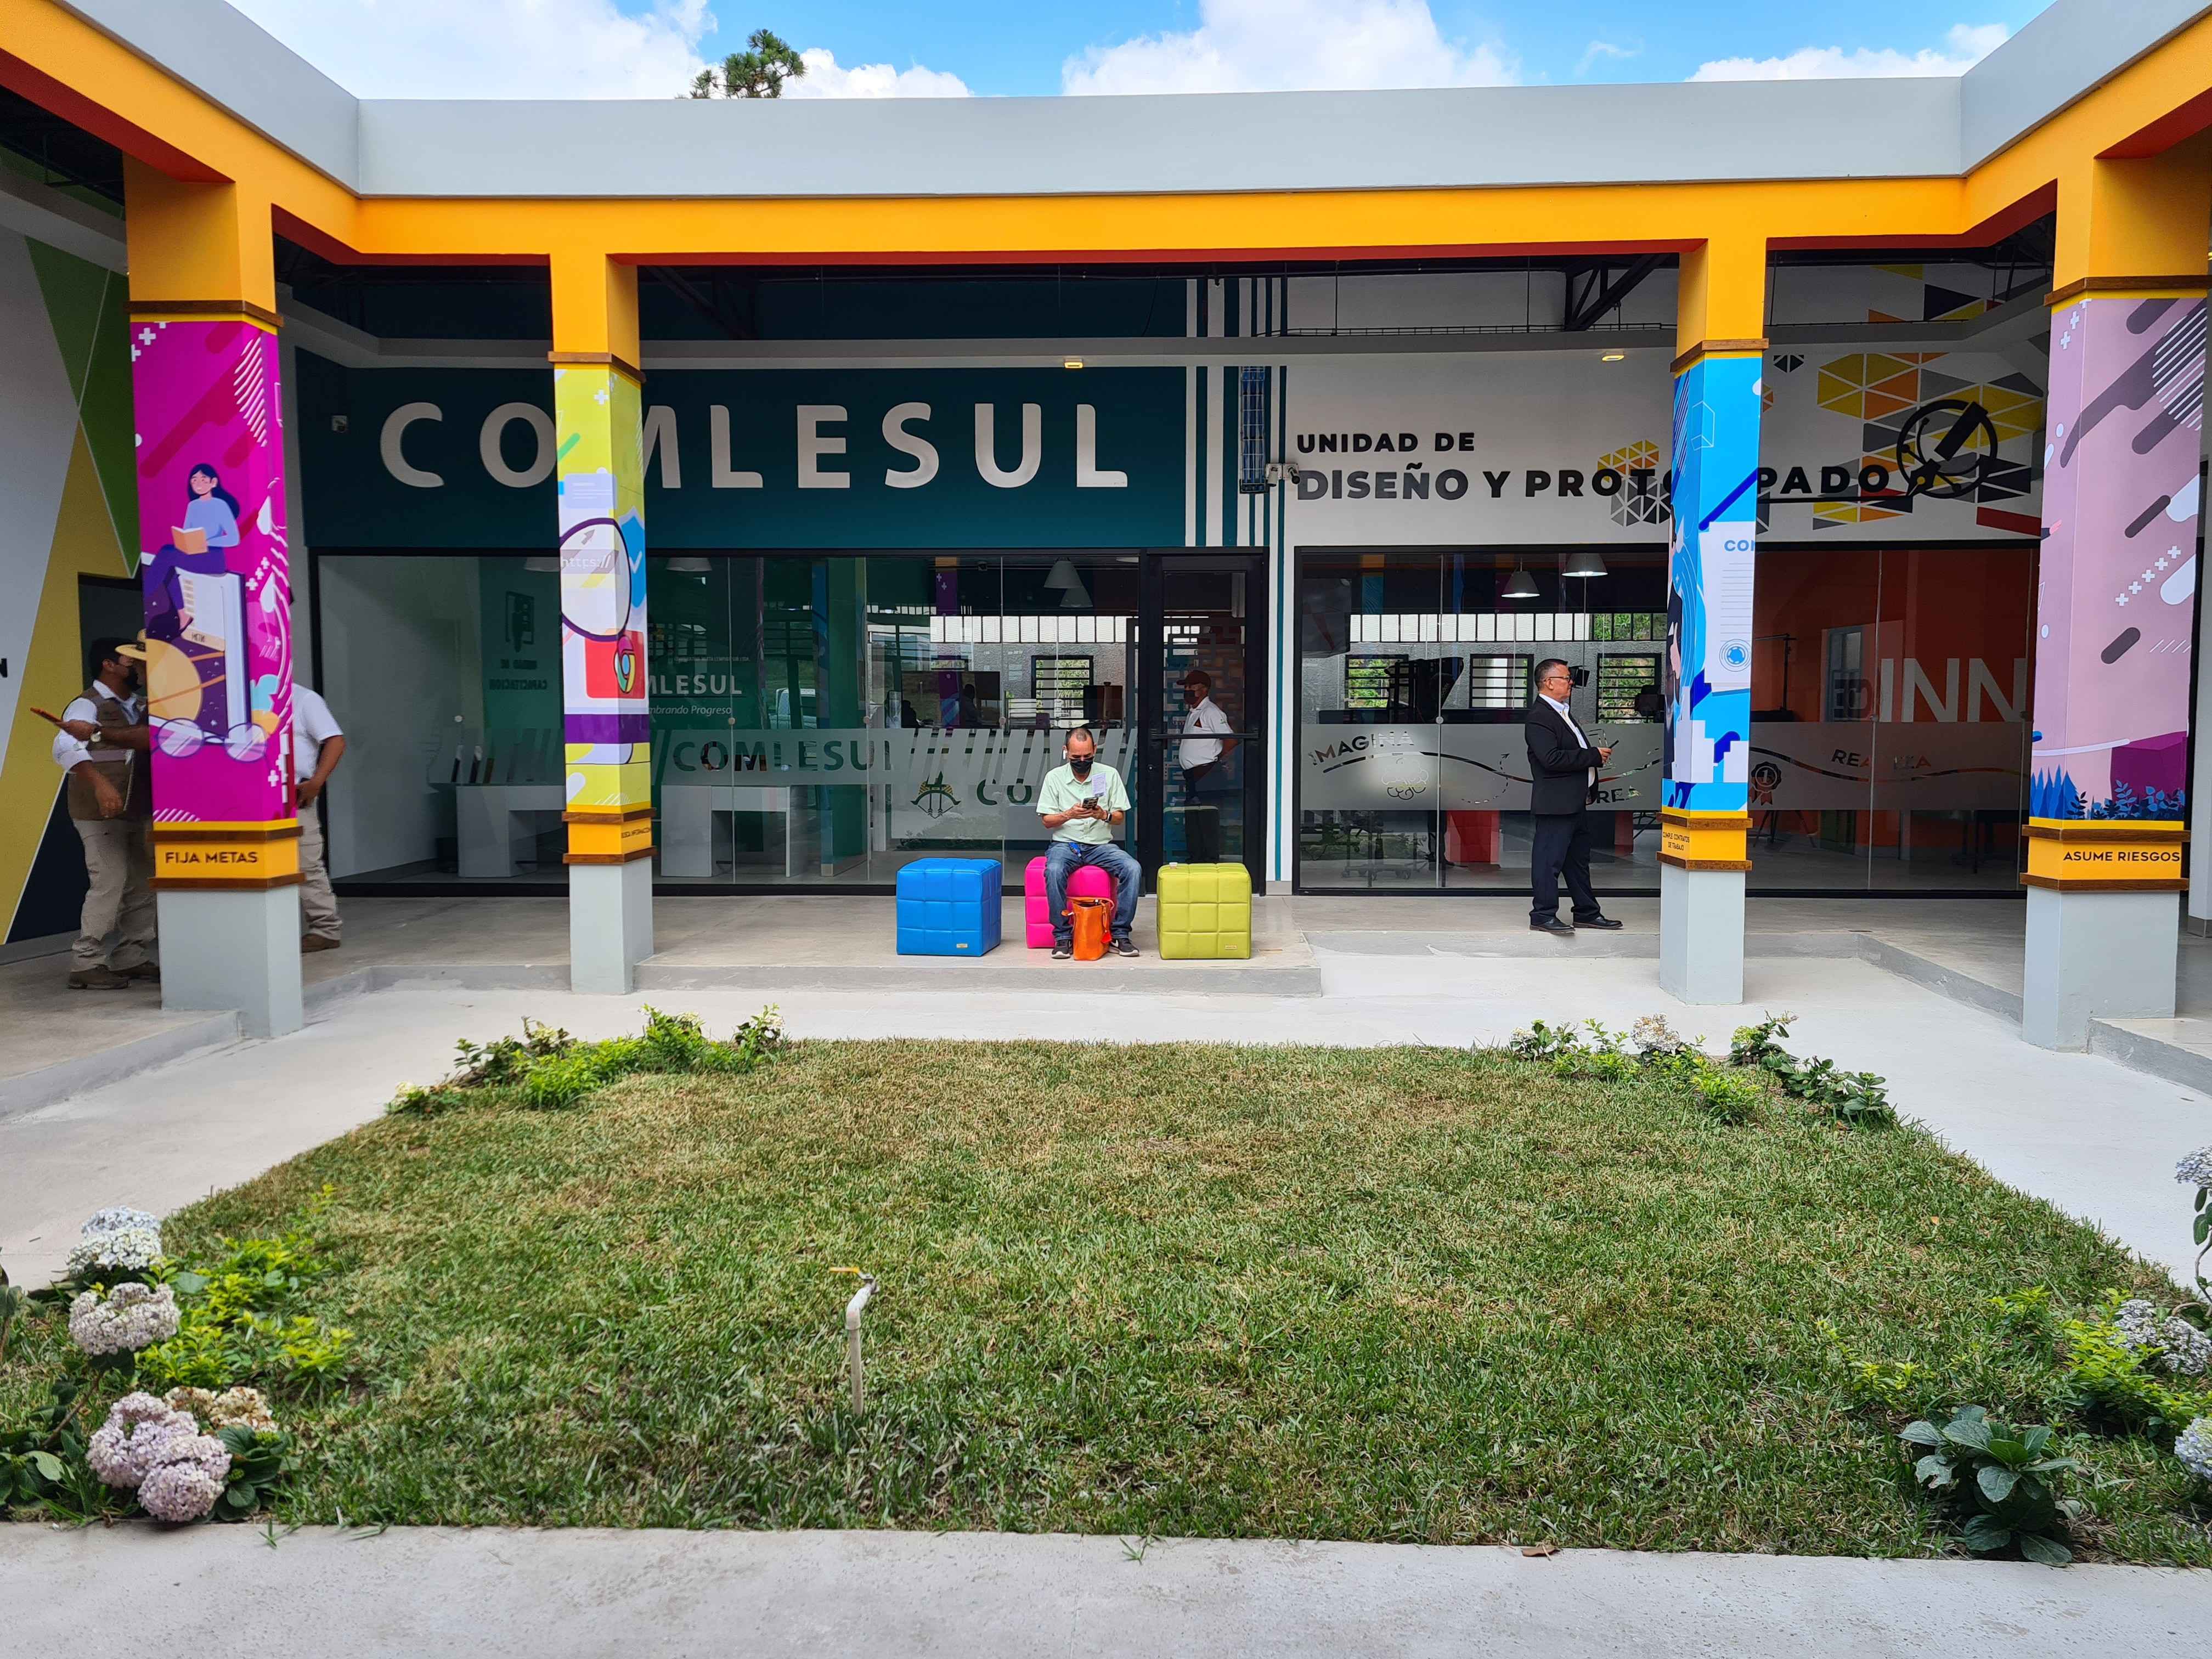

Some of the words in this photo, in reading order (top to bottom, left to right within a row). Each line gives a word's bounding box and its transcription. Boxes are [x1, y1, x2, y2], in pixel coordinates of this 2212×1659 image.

[1297, 433, 1418, 453] UNIDAD
[1434, 432, 1475, 452] DE
[1297, 462, 1469, 500] DISEÑO
[1482, 471, 1510, 498] Y
[691, 705, 733, 716] Progreso
[165, 851, 200, 864] FIJA
[205, 851, 258, 864] METAS
[2063, 851, 2113, 861] ASUME
[2118, 851, 2180, 862] RIESGOS
